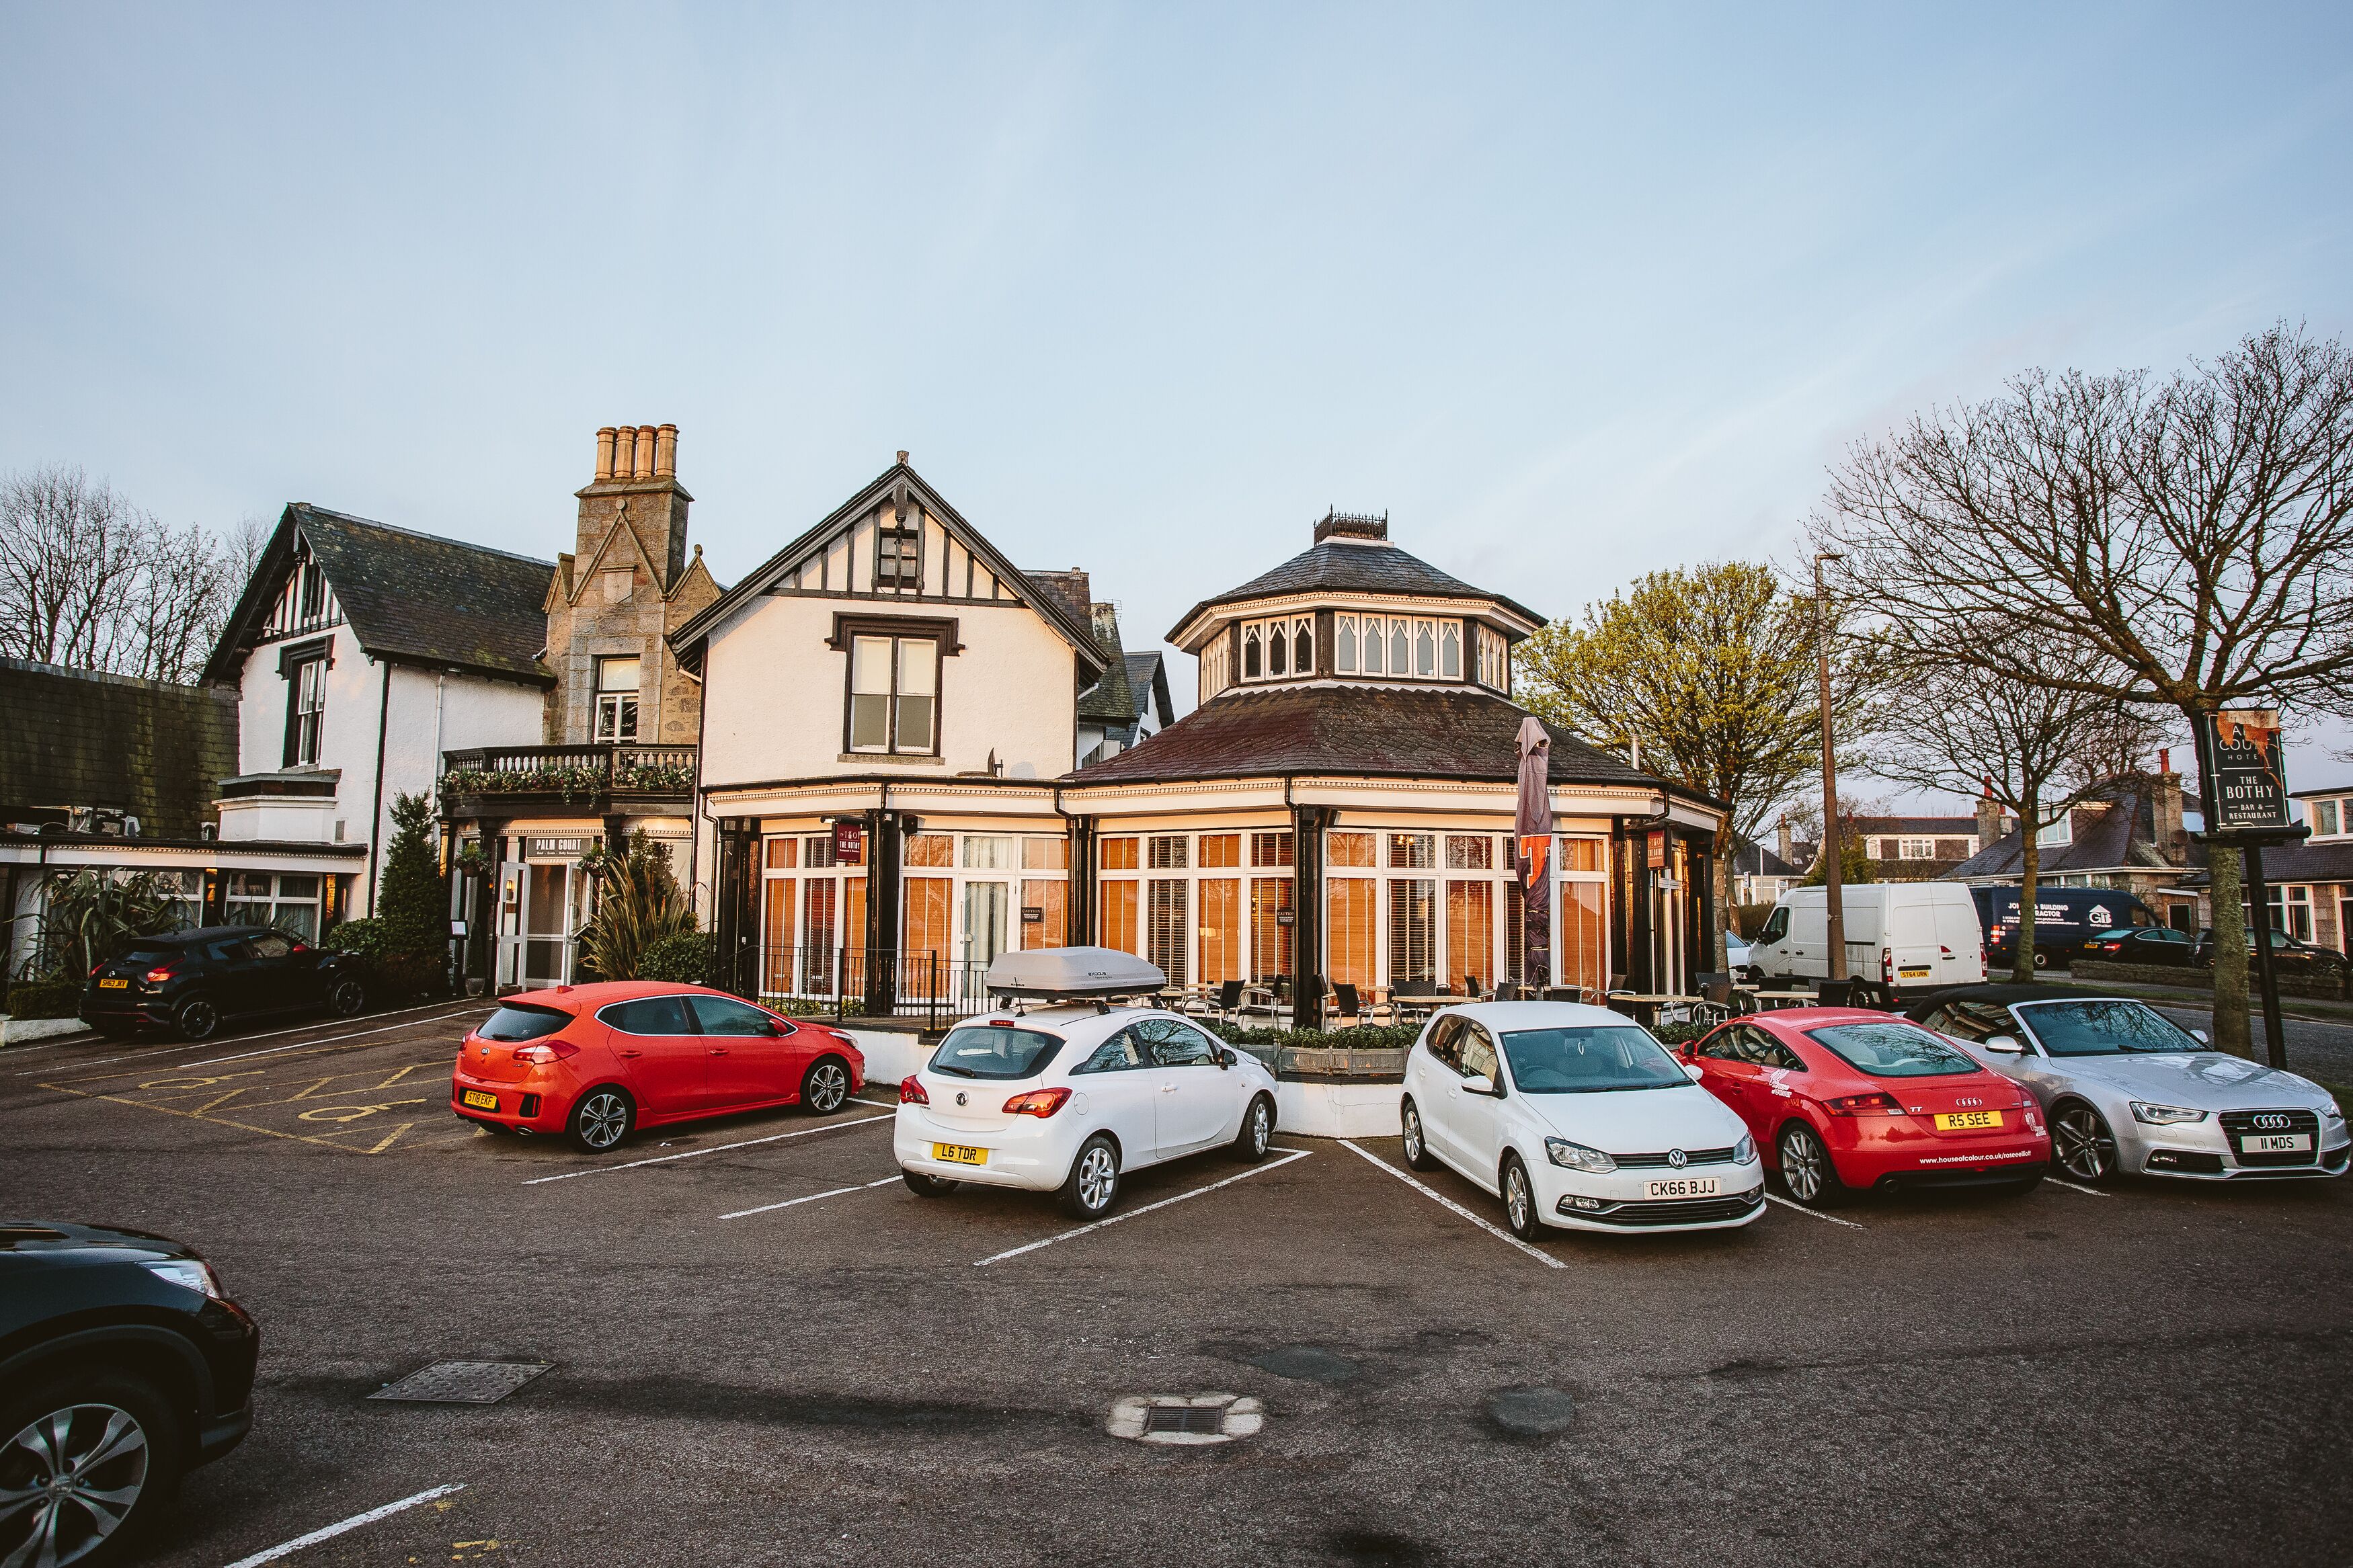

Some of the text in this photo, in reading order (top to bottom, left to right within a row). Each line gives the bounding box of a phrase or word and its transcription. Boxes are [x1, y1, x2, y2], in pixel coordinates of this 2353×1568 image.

[2239, 776, 2258, 784] THE
[2226, 785, 2274, 798] BOTHY
[2229, 811, 2277, 819] RESTAURANT
[536, 839, 582, 850] PALM COURT
[2040, 903, 2069, 911] BUILDING
[468, 1091, 493, 1106] ST18 EKF
[1948, 1112, 1991, 1127] R5 SEE
[2270, 1137, 2294, 1149] MDS
[941, 1145, 976, 1161] L6 TDR
[1650, 1180, 1715, 1196] CK66 BJJ
